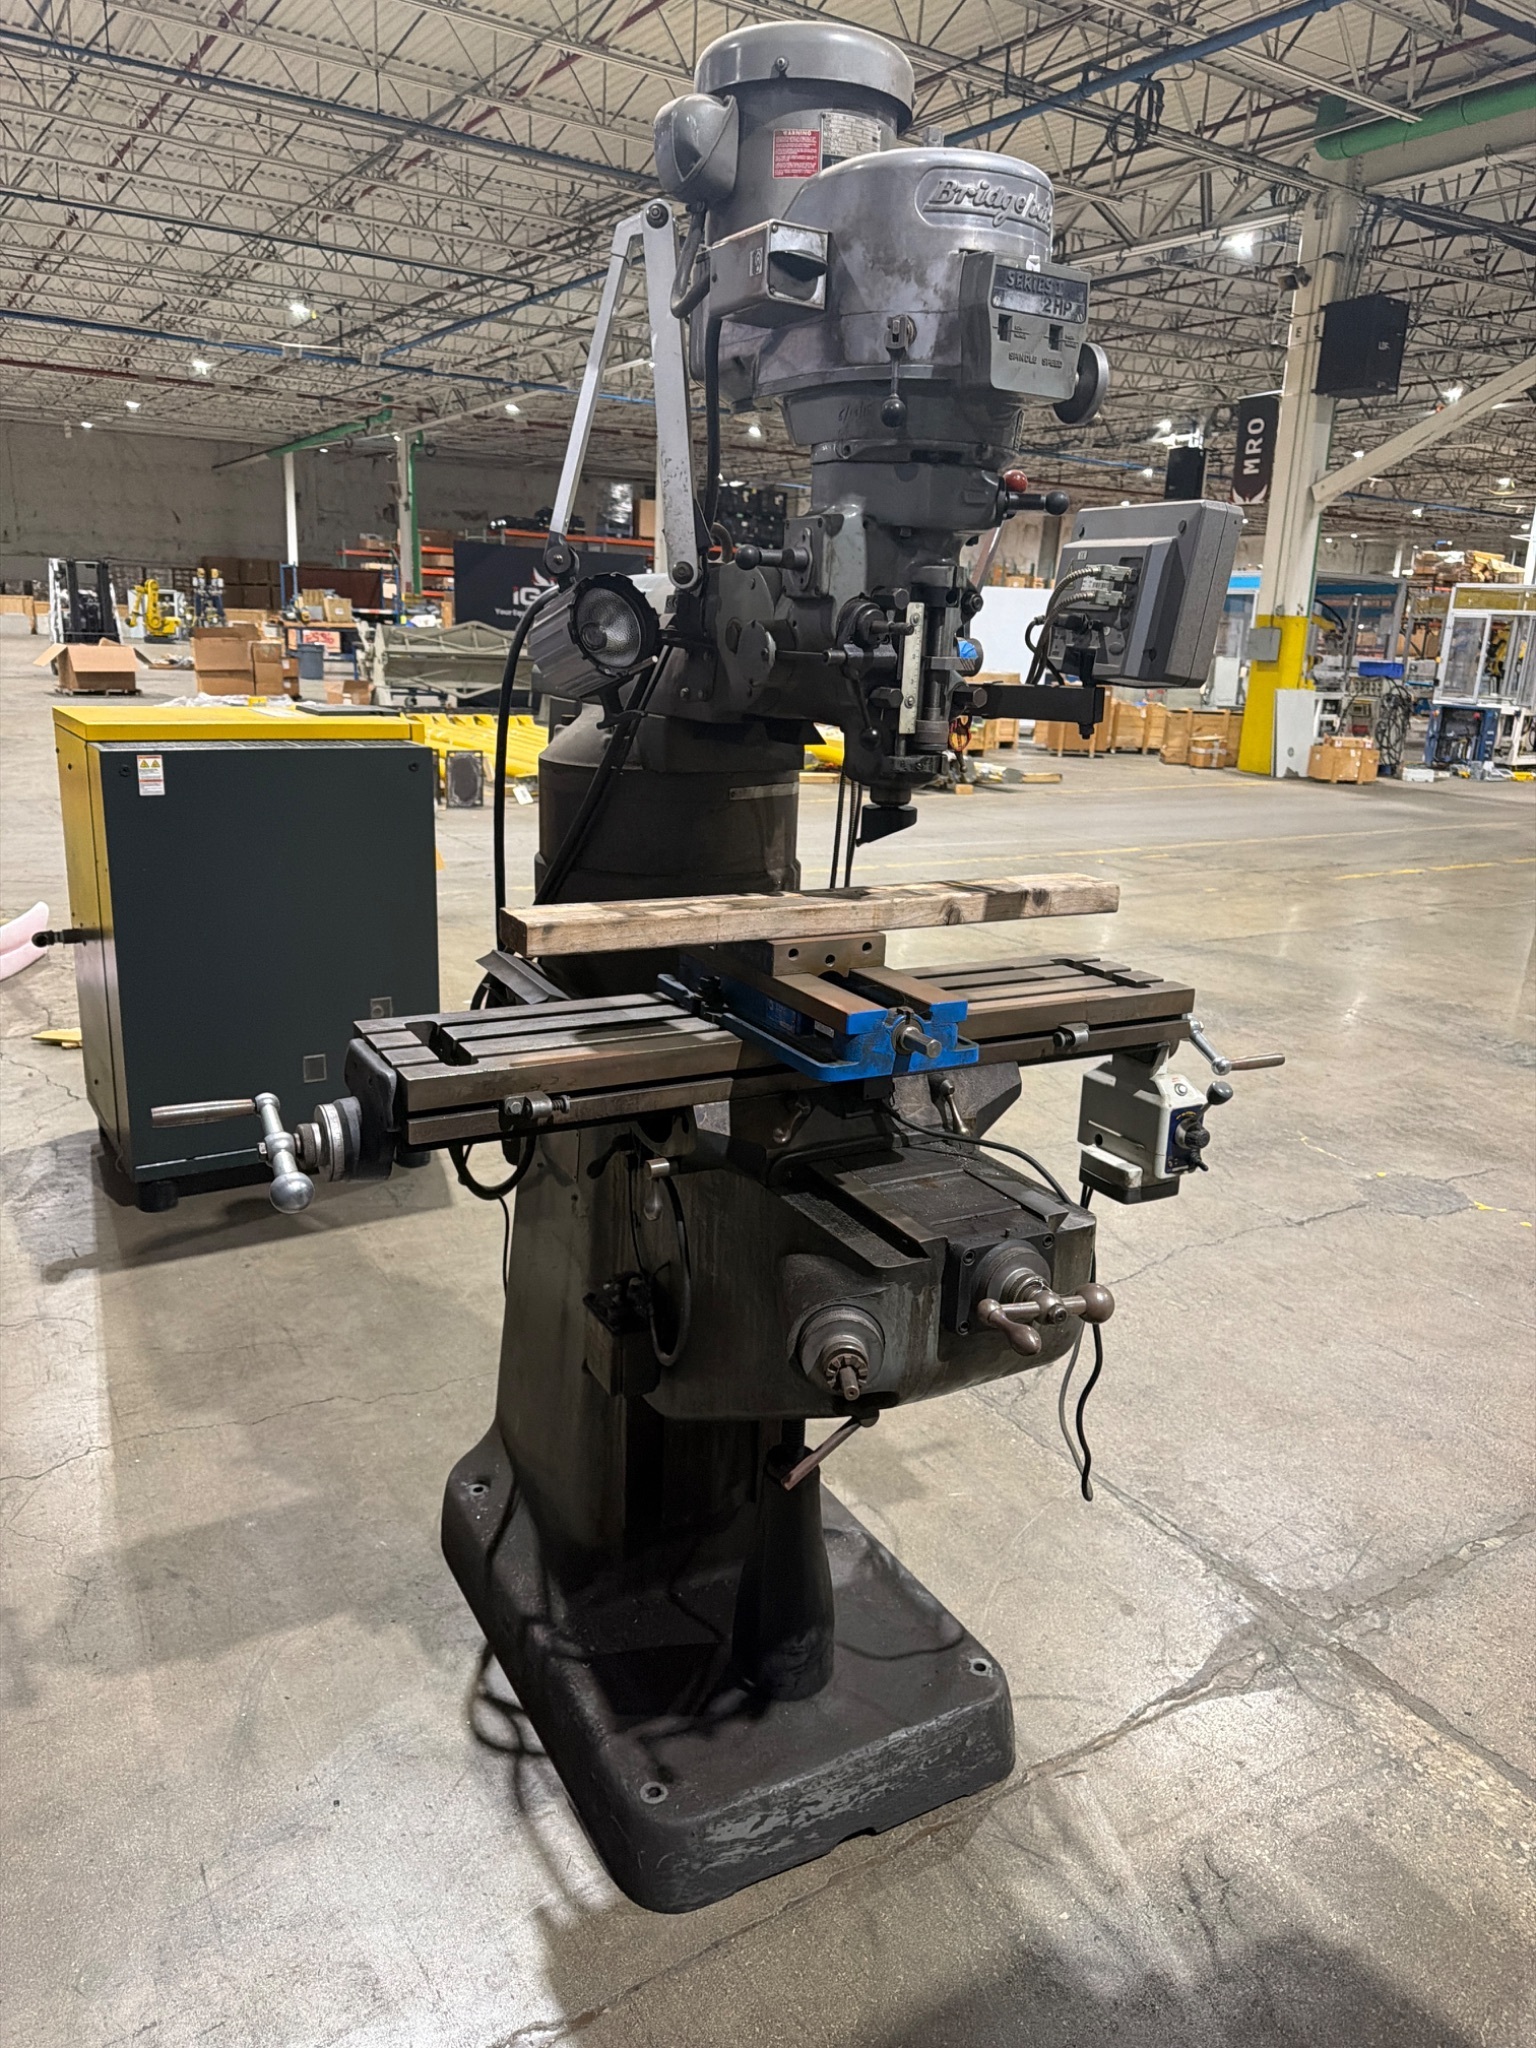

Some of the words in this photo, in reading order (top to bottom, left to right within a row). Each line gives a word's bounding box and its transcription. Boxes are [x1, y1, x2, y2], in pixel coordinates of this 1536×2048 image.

[1006, 270, 1053, 296] SERIES
[1042, 297, 1072, 316] 2HP
[1243, 417, 1265, 475] MRO
